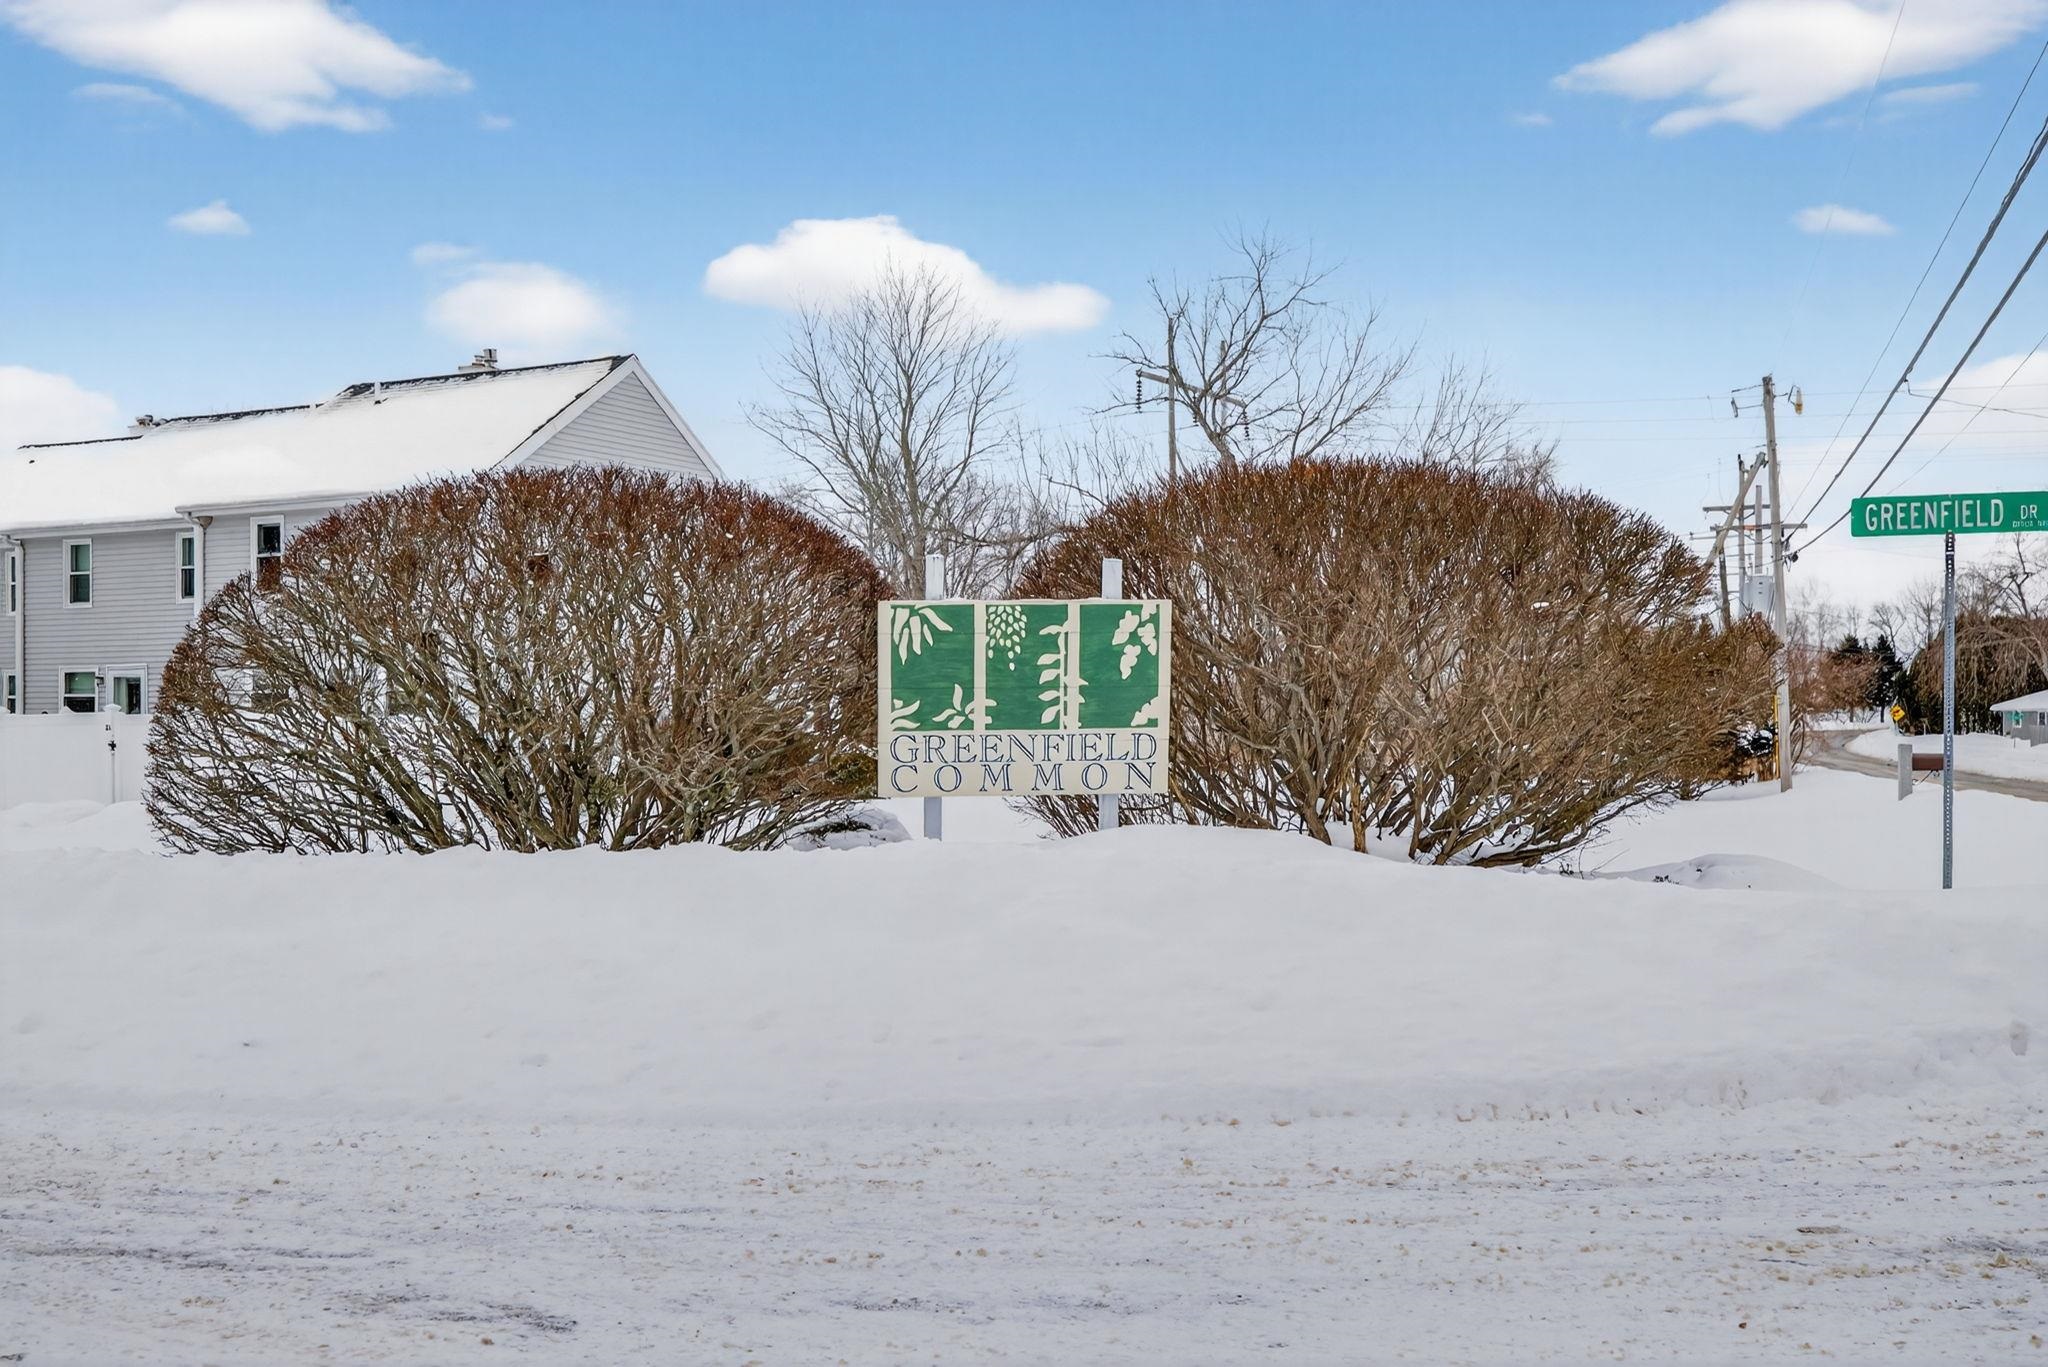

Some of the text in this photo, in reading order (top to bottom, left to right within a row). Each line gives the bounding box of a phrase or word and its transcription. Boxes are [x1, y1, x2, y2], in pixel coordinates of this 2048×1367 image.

[1865, 499, 2038, 531] GREENFIELD DR
[889, 732, 1157, 764] GREENFIELD
[890, 762, 1156, 793] COMMON
